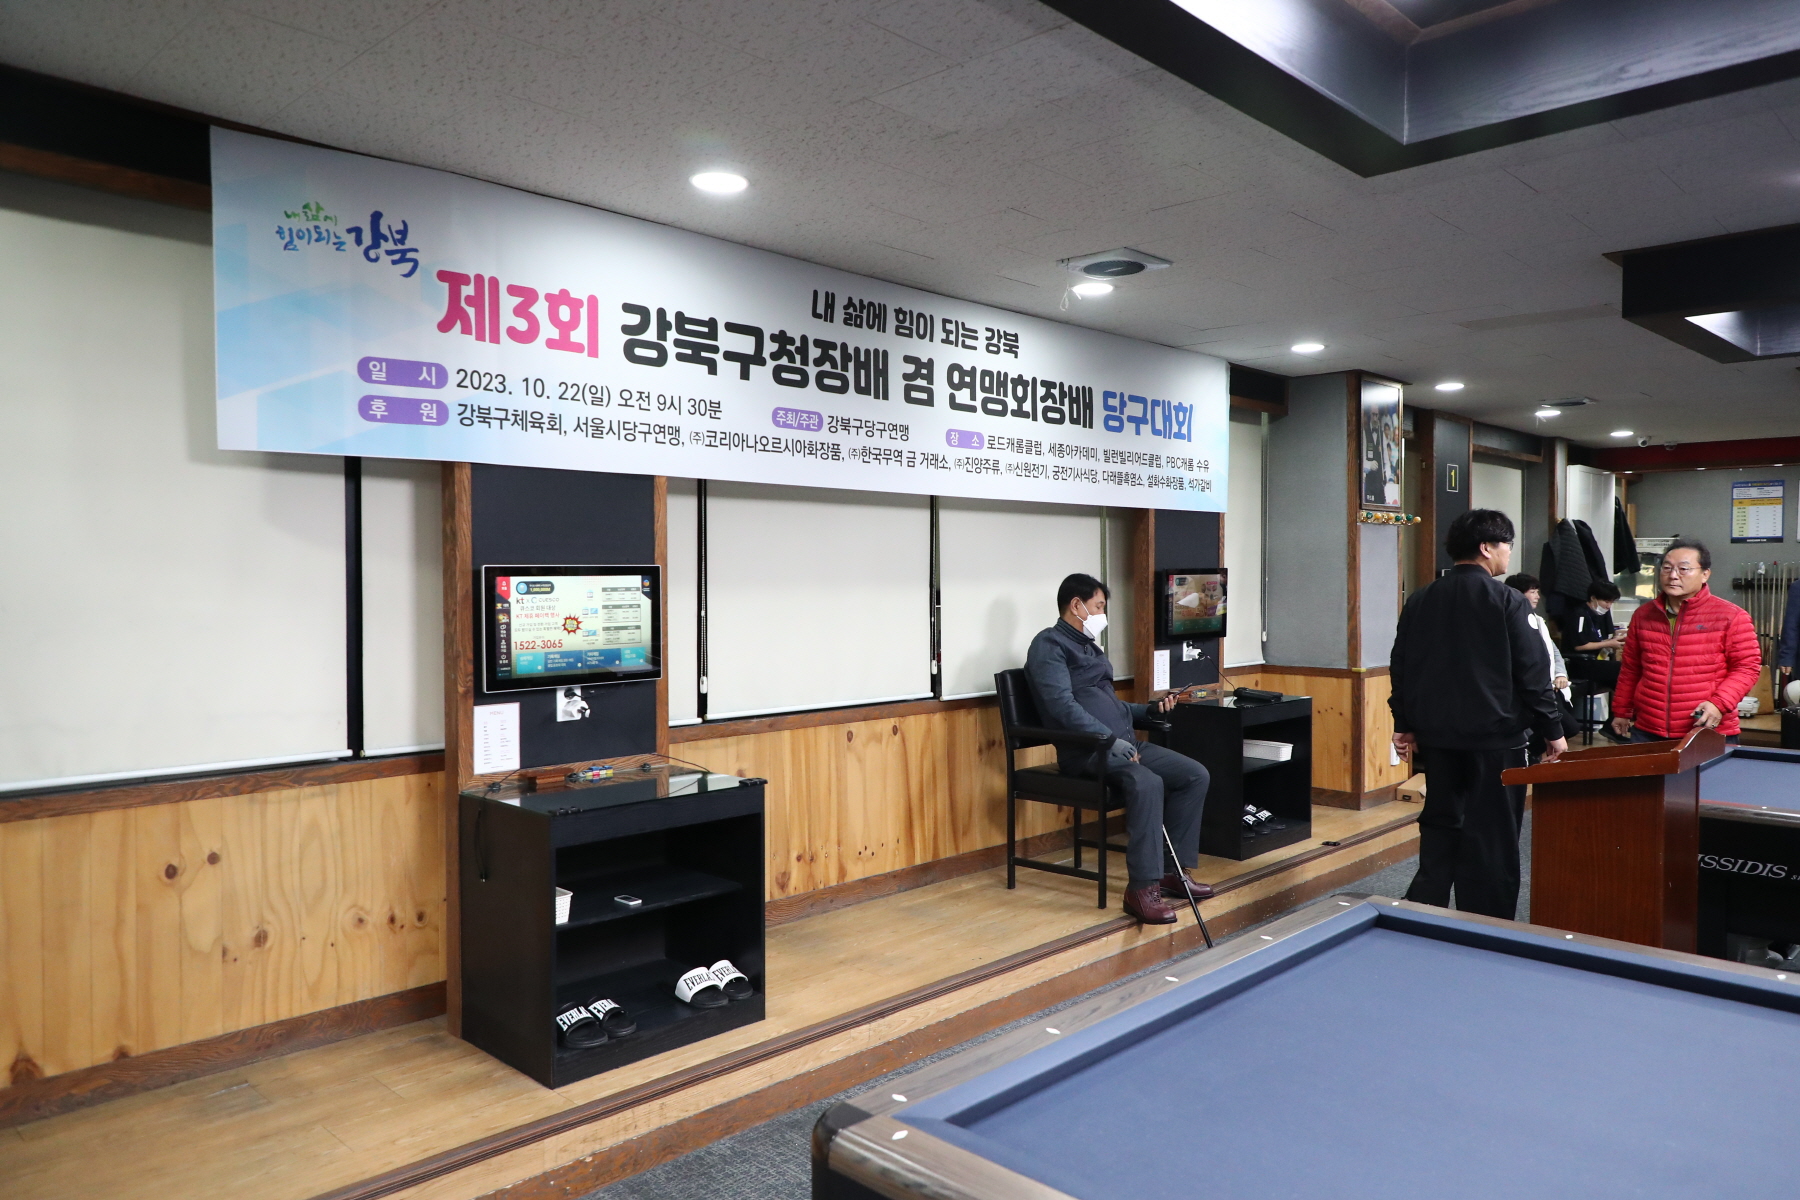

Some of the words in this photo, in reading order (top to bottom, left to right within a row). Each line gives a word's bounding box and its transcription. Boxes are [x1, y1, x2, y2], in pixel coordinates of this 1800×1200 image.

[284, 209, 300, 220] 내
[303, 201, 338, 226] 삶에
[346, 210, 420, 278] 강북
[811, 289, 836, 324] 내
[842, 298, 888, 334] 삶에
[893, 306, 935, 343] 힘이
[940, 317, 980, 352] 되는
[984, 326, 1020, 359] 강북
[435, 269, 600, 359] 제3회
[620, 301, 890, 401] 강북구청장배
[901, 354, 936, 408] 겸
[946, 361, 1095, 430] 연맹회장배
[1102, 389, 1195, 443] 당구대회
[455, 368, 513, 396] 2023.
[521, 376, 551, 400] 10.
[557, 381, 612, 408] 22(일)
[617, 388, 652, 412] 오전
[656, 393, 683, 416] 9시
[687, 397, 723, 421] 30분
[456, 402, 568, 437] 강북구체육회,
[572, 416, 685, 448] 서울시당구연맹,
[905, 450, 917, 468] 금
[919, 450, 952, 473] 거래소,
[775, 409, 821, 431] 주최/주관
[826, 414, 910, 442] 강북구당구연맹
[986, 434, 1046, 457] 로드캐롬클럽,
[1047, 441, 1101, 463] 세종아카데미,
[1196, 459, 1210, 474] 수유
[516, 596, 525, 605] kt
[513, 638, 564, 650] 1522-3065
[1697, 854, 1789, 879] SSIDIS
